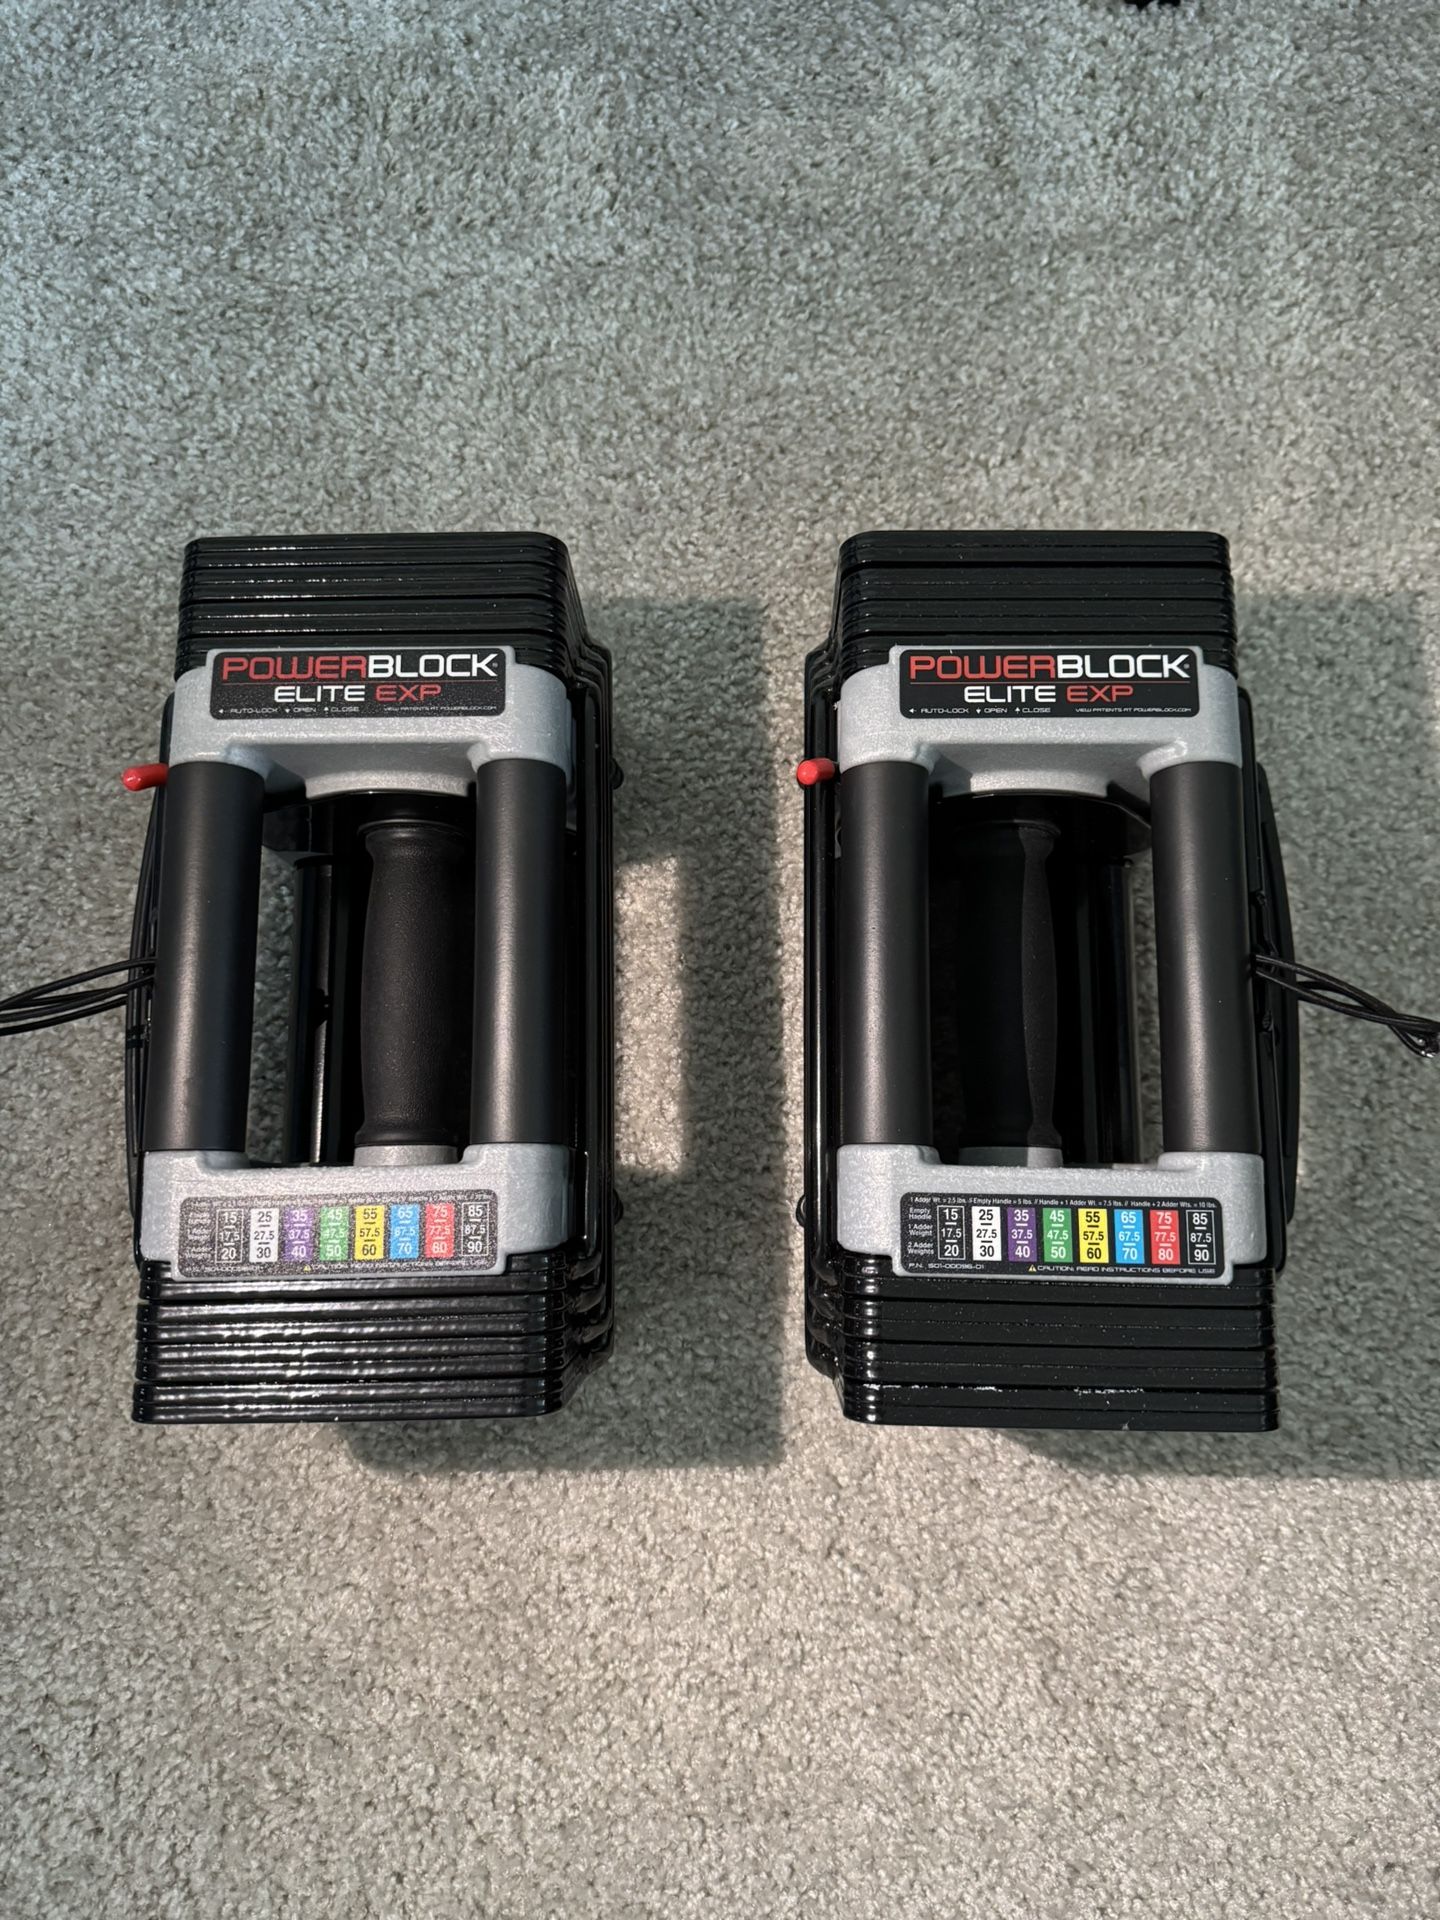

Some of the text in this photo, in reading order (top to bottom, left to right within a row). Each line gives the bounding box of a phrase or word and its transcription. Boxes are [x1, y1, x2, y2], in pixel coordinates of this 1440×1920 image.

[274, 684, 441, 702] ELITE EXP
[964, 685, 1134, 703] ELITE EXP
[1130, 1200, 1151, 1208] Handle
[223, 1211, 237, 1223] 15
[258, 1211, 272, 1223] 25
[292, 1210, 307, 1222] 35
[327, 1209, 342, 1221] 45
[363, 1207, 378, 1220] 55
[398, 1206, 414, 1219] 65
[433, 1204, 448, 1218] 75
[468, 1204, 483, 1217] 85
[943, 1208, 1208, 1225] 15 25 35 45 55 65 75 85
[219, 1231, 240, 1242] 17.5
[254, 1230, 275, 1241] 27.5
[289, 1229, 310, 1239] 37.5
[323, 1228, 345, 1239] 47.5
[359, 1227, 380, 1238] 57.5
[430, 1225, 451, 1235] 77.5
[465, 1224, 486, 1235] 87.5
[941, 1228, 1212, 1243] 17.5 27.5 37.5 47.5 57.5 67.5 77.5 87.5
[221, 1247, 237, 1260] 20
[256, 1246, 271, 1259] 30
[291, 1245, 306, 1258] 40
[325, 1244, 341, 1257] 50
[362, 1243, 377, 1256] 60
[397, 1242, 412, 1255] 70
[432, 1241, 448, 1254] 80
[467, 1240, 482, 1253] 90
[944, 1244, 1210, 1262] 20 30 40 50 60 70 80 90
[1101, 1266, 1160, 1274] INSTRUCTIONS
